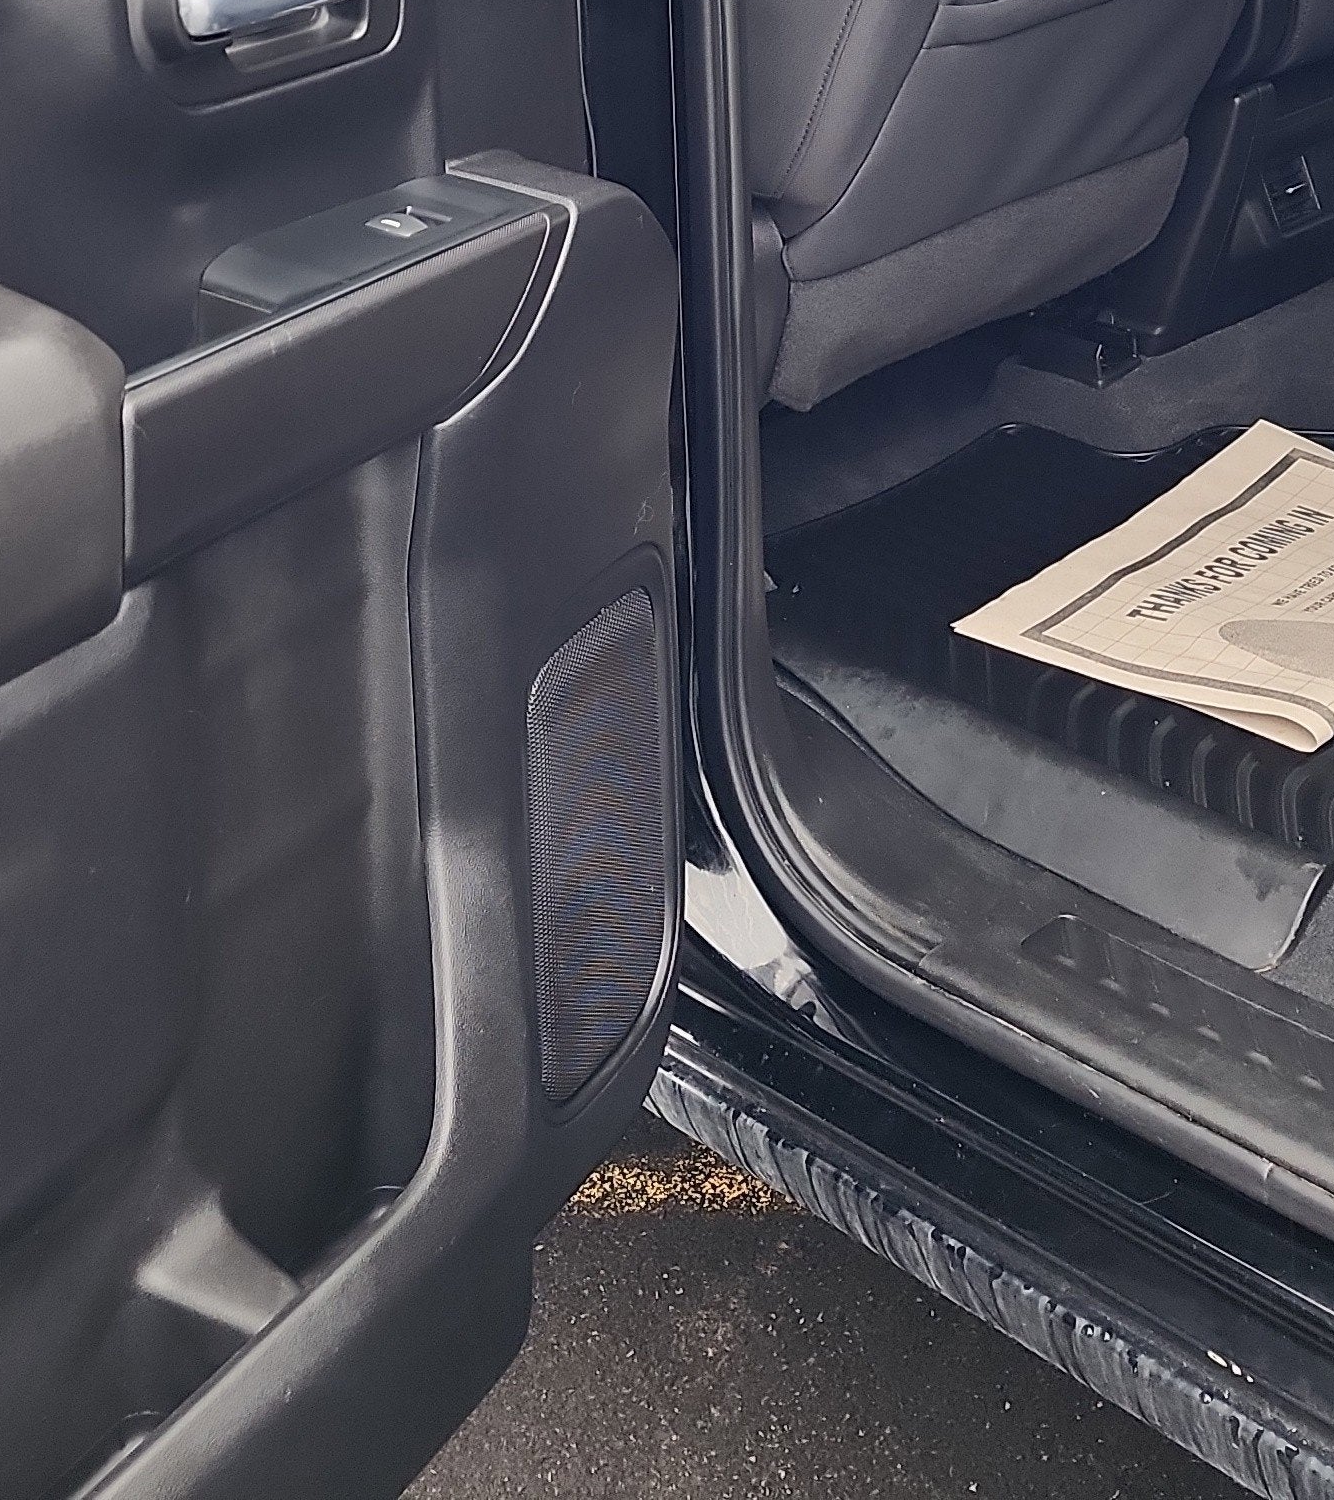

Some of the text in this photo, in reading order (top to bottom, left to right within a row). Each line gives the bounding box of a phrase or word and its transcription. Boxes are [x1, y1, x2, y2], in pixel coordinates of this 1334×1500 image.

[1126, 505, 1334, 621] THANKS FOR COMING IN
